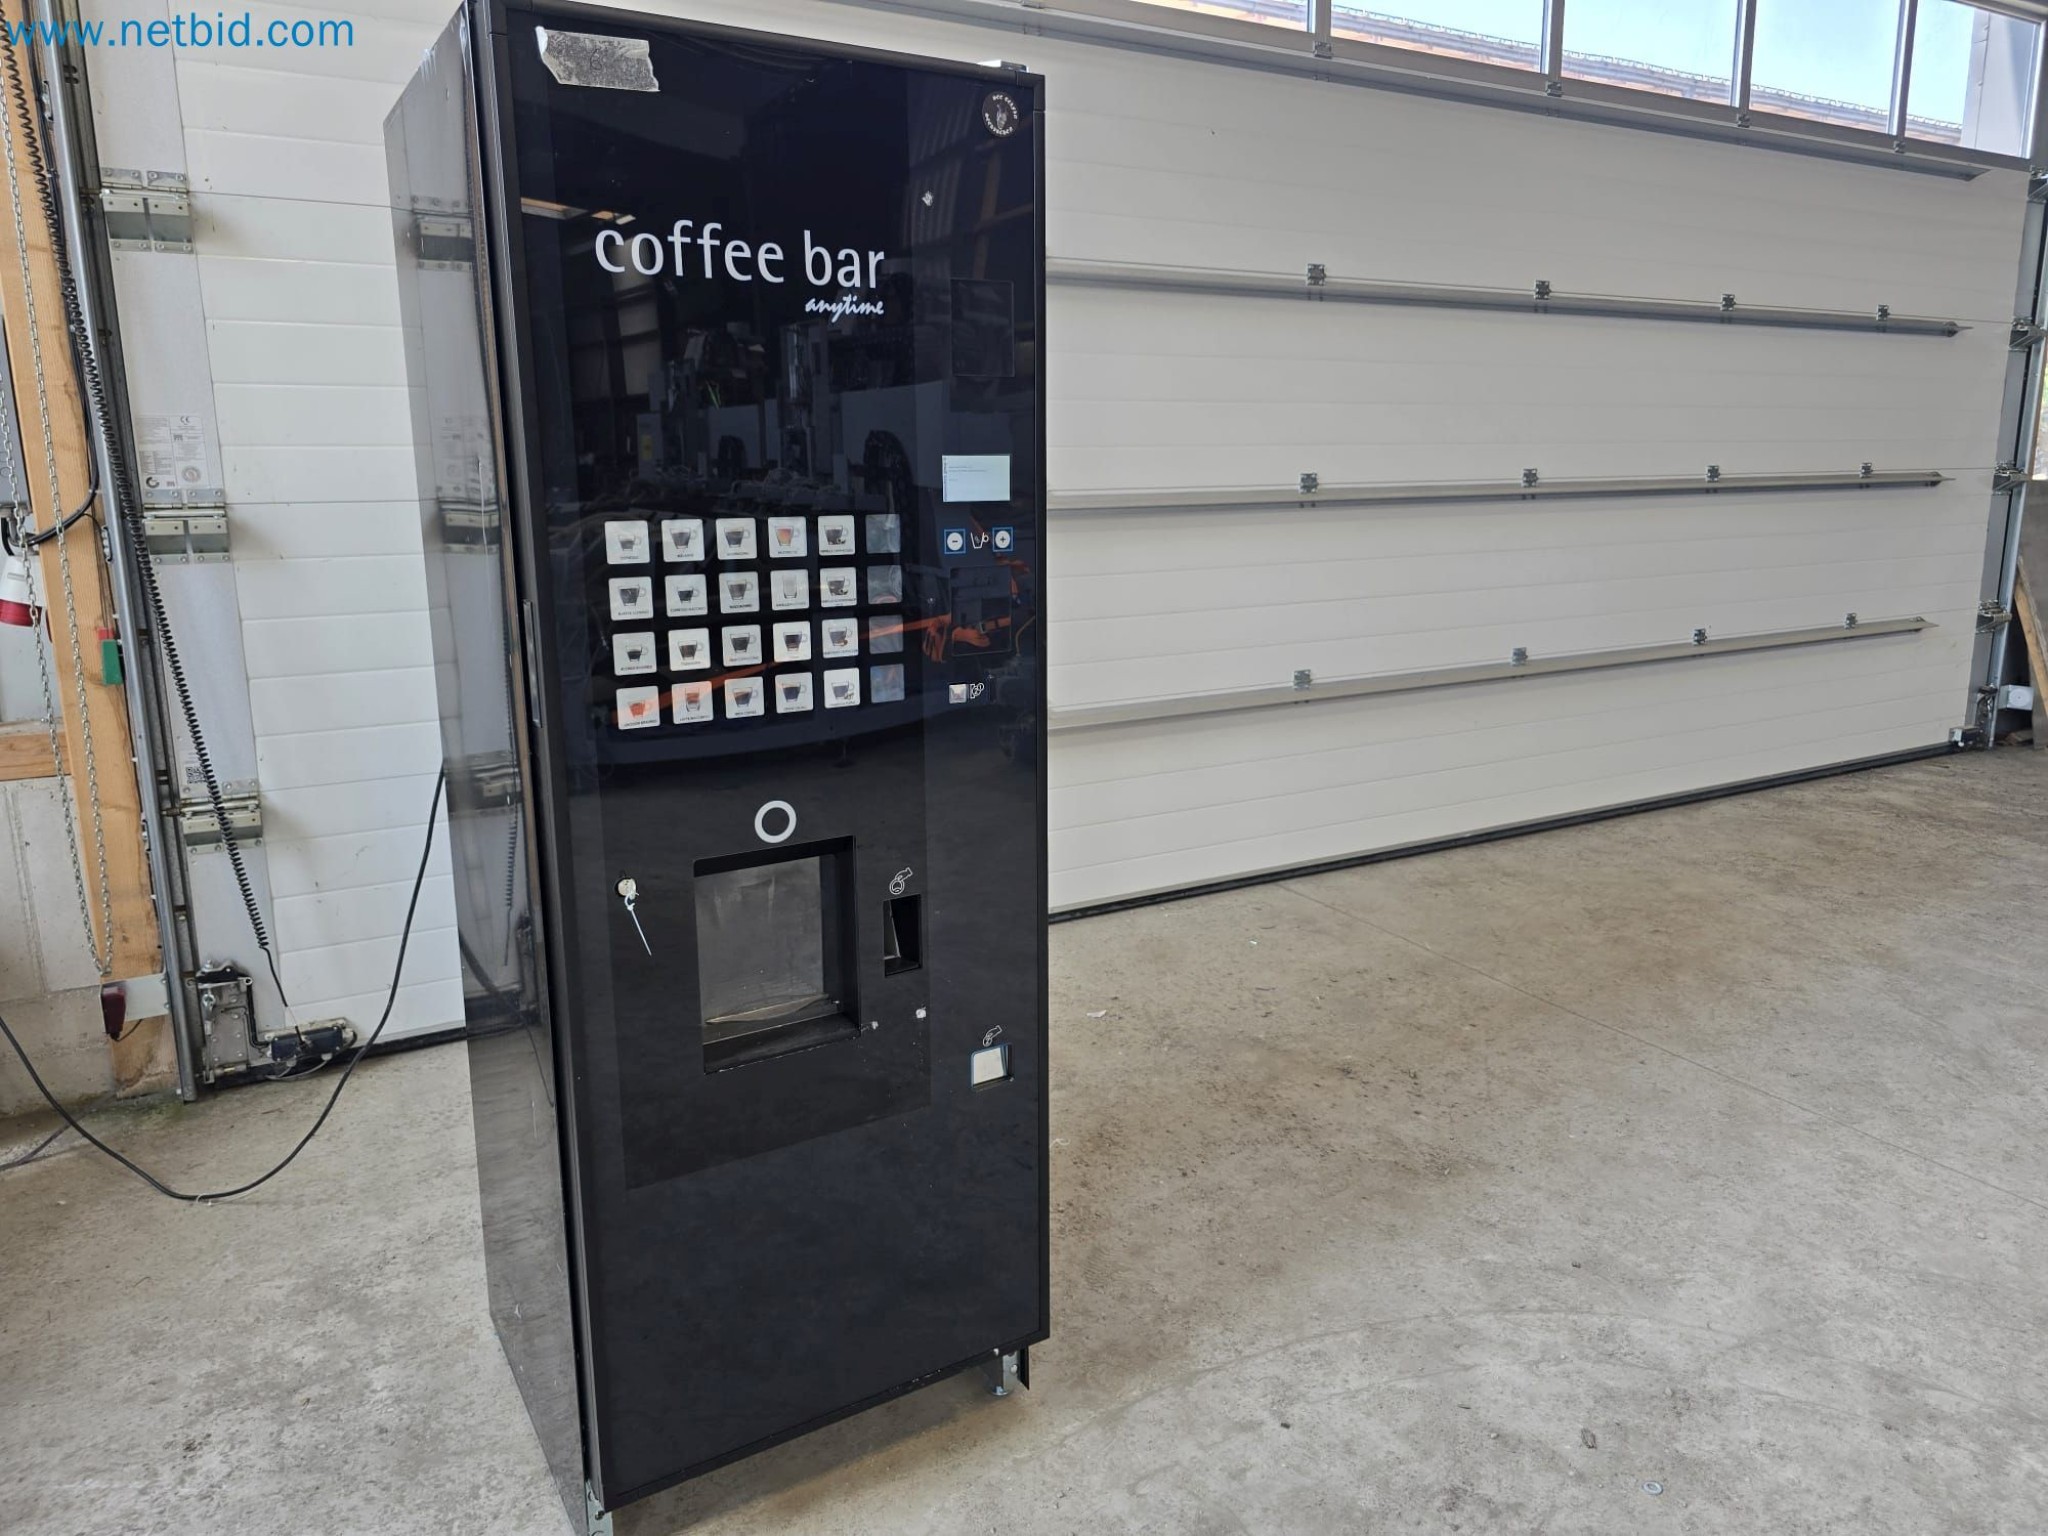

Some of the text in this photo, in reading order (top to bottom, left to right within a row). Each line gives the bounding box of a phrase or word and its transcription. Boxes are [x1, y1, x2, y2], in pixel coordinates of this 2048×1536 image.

[595, 219, 885, 289] coffee bar
[805, 294, 885, 323] anytime
